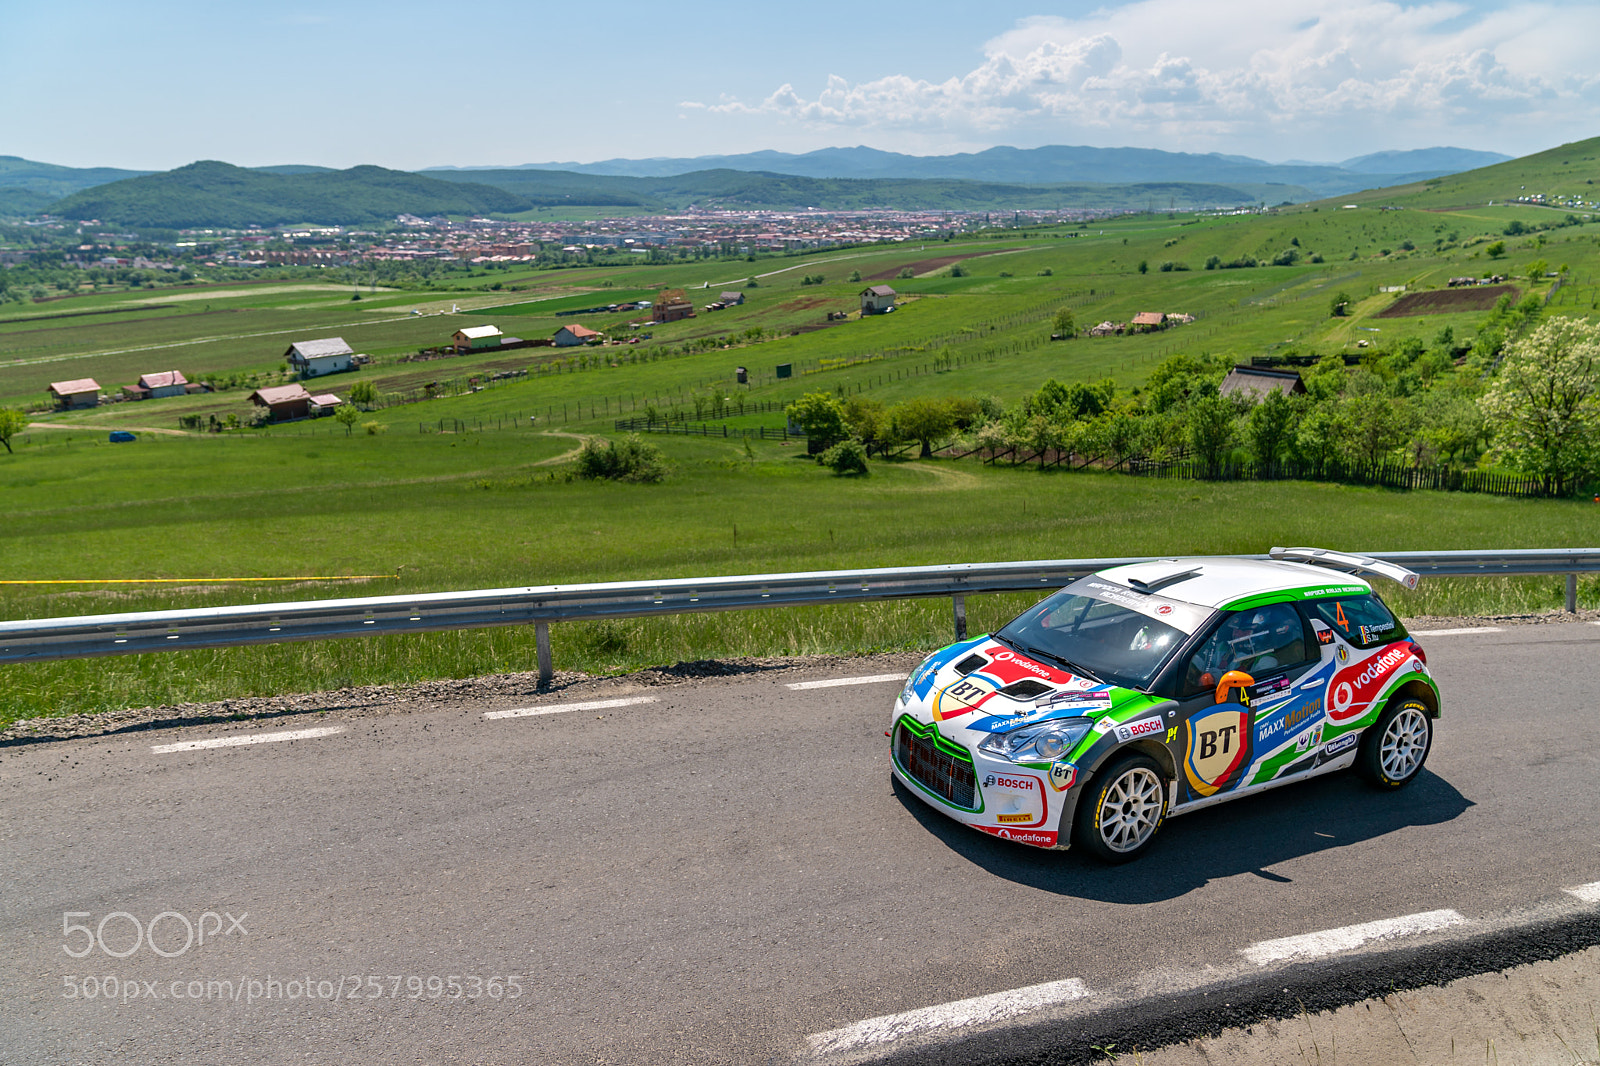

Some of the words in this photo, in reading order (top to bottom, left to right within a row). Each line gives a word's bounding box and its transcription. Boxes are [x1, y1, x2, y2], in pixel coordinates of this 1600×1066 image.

[1336, 602, 1349, 632] 4
[1011, 658, 1050, 678] vodafone
[1353, 648, 1405, 689] vodafone
[951, 681, 986, 701] BT
[1240, 687, 1250, 706] 4
[1130, 720, 1162, 736] BOSCH
[1200, 725, 1236, 759] BT
[1054, 766, 1072, 780] BT
[997, 778, 1033, 790] BOSCH
[1011, 834, 1052, 843] vodafone
